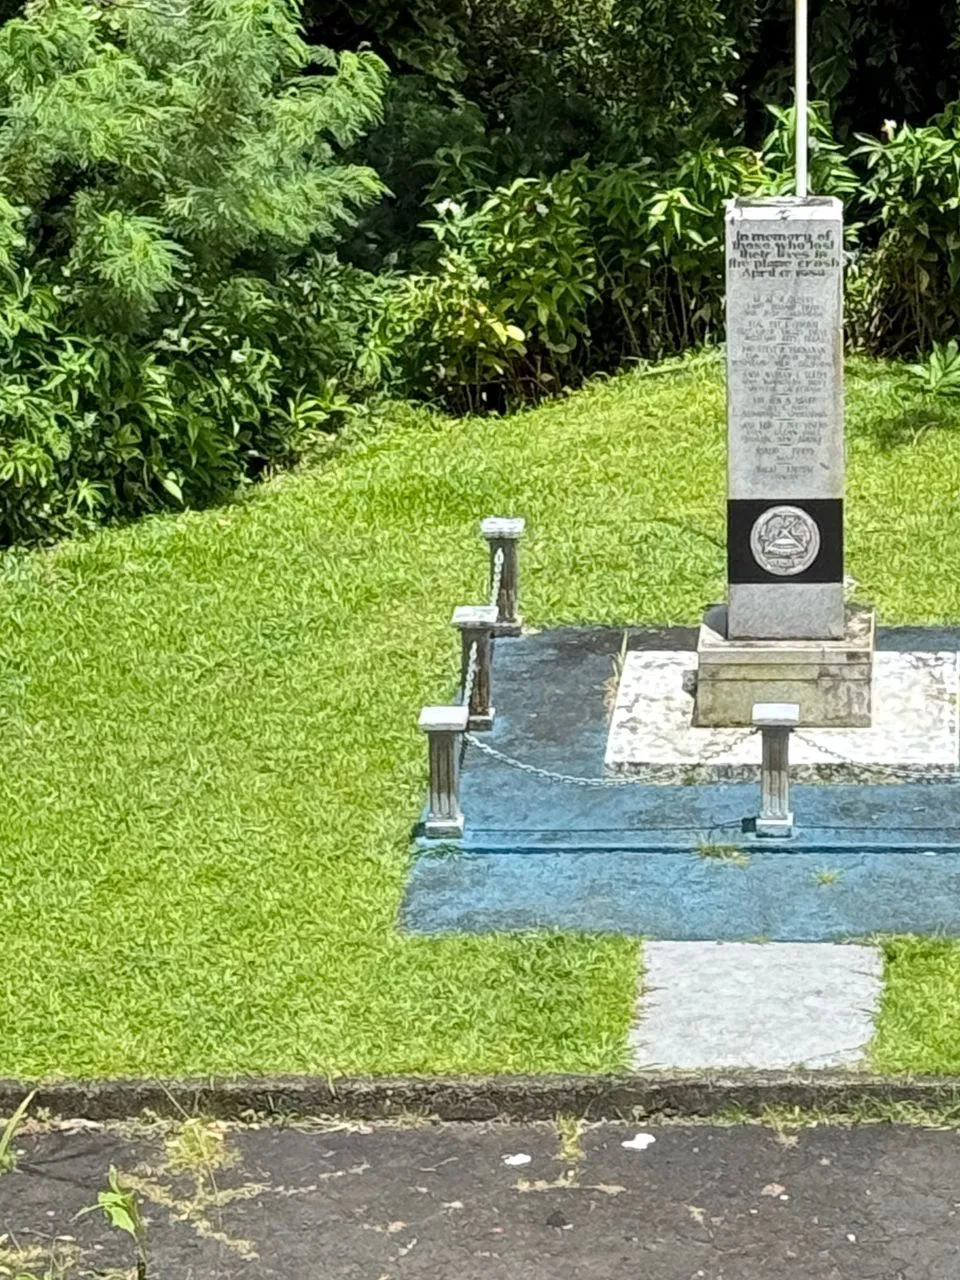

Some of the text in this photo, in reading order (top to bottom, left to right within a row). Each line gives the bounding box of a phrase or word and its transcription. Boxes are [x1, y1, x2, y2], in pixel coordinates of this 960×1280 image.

[751, 232, 812, 243] memory
[817, 230, 832, 241] of
[733, 240, 834, 250] those who lost
[740, 249, 828, 259] their lives in
[728, 258, 750, 268] the
[797, 258, 840, 268] crash
